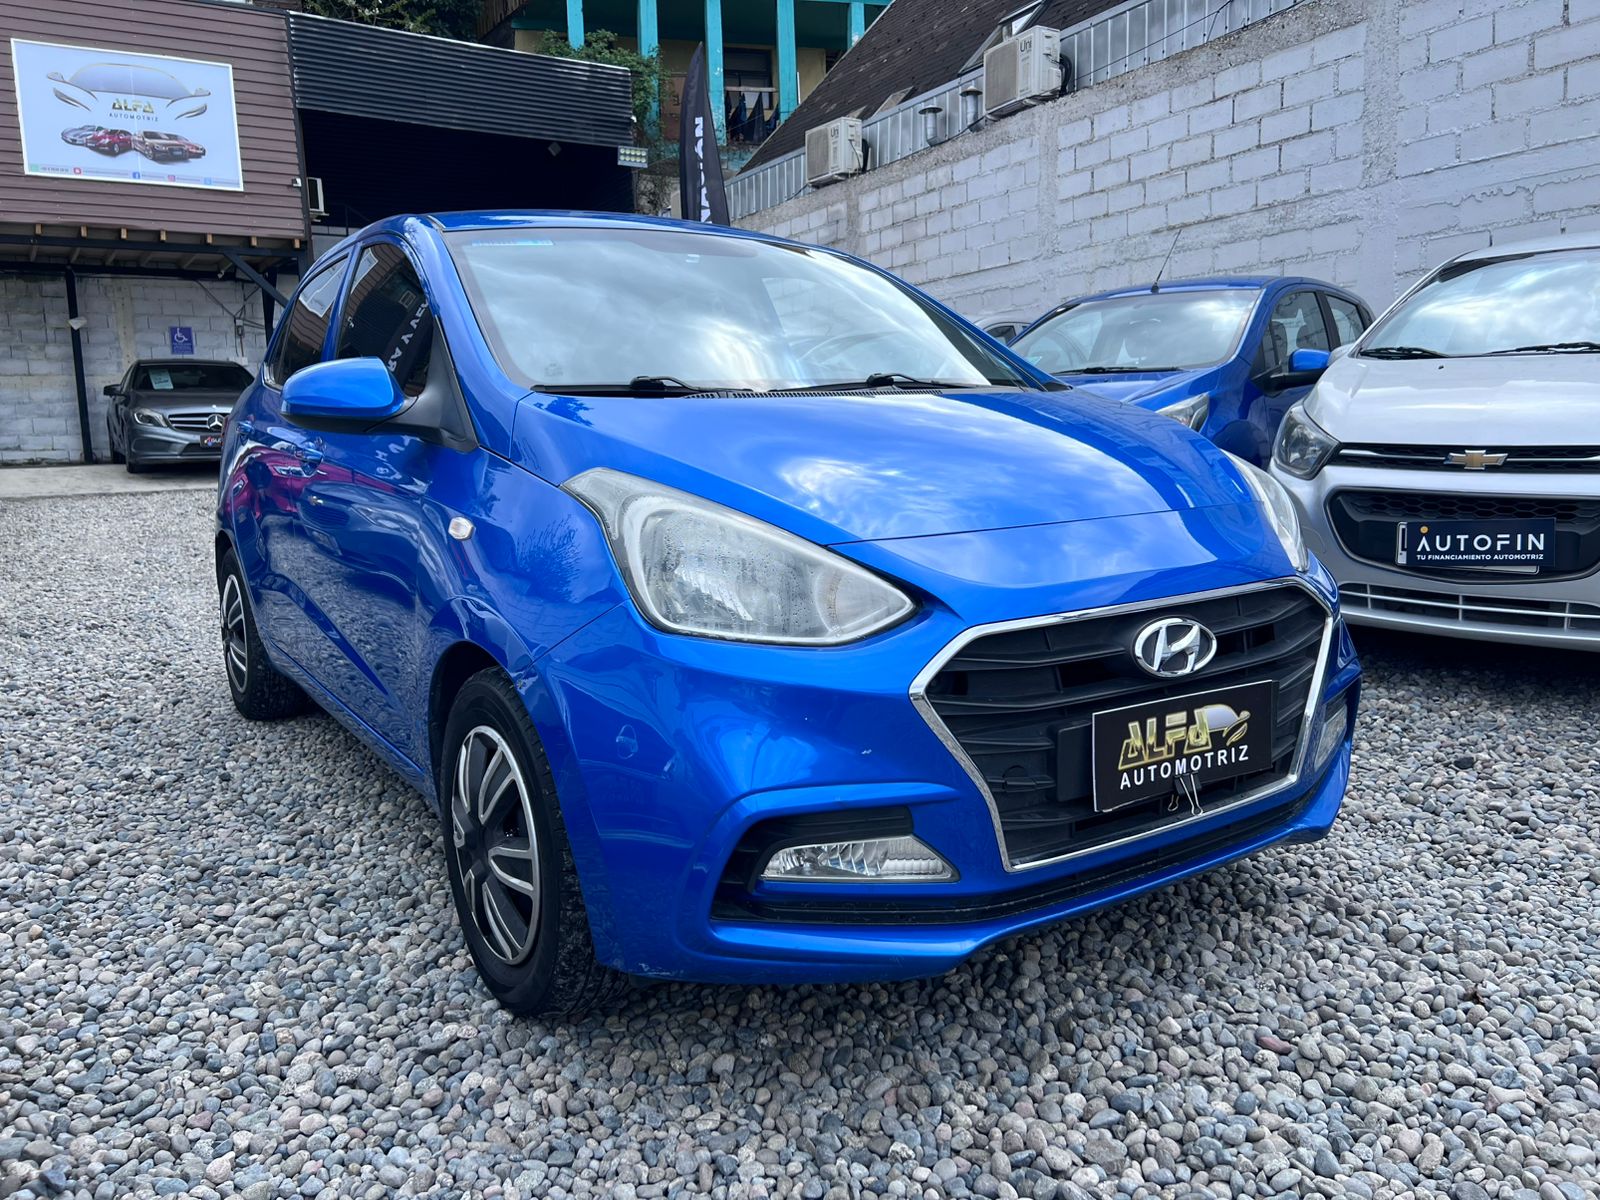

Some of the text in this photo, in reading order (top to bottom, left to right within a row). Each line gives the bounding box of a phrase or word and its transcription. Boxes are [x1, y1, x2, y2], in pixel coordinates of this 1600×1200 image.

[112, 98, 154, 113] ALFA
[109, 112, 158, 122] AUTOMOTRIZ
[1416, 532, 1544, 551] AUTOFIN
[1492, 553, 1544, 561] AUTOMOTRIZ
[1118, 708, 1212, 770] ALFA
[1120, 744, 1249, 790] AUTOMOTRIZ
